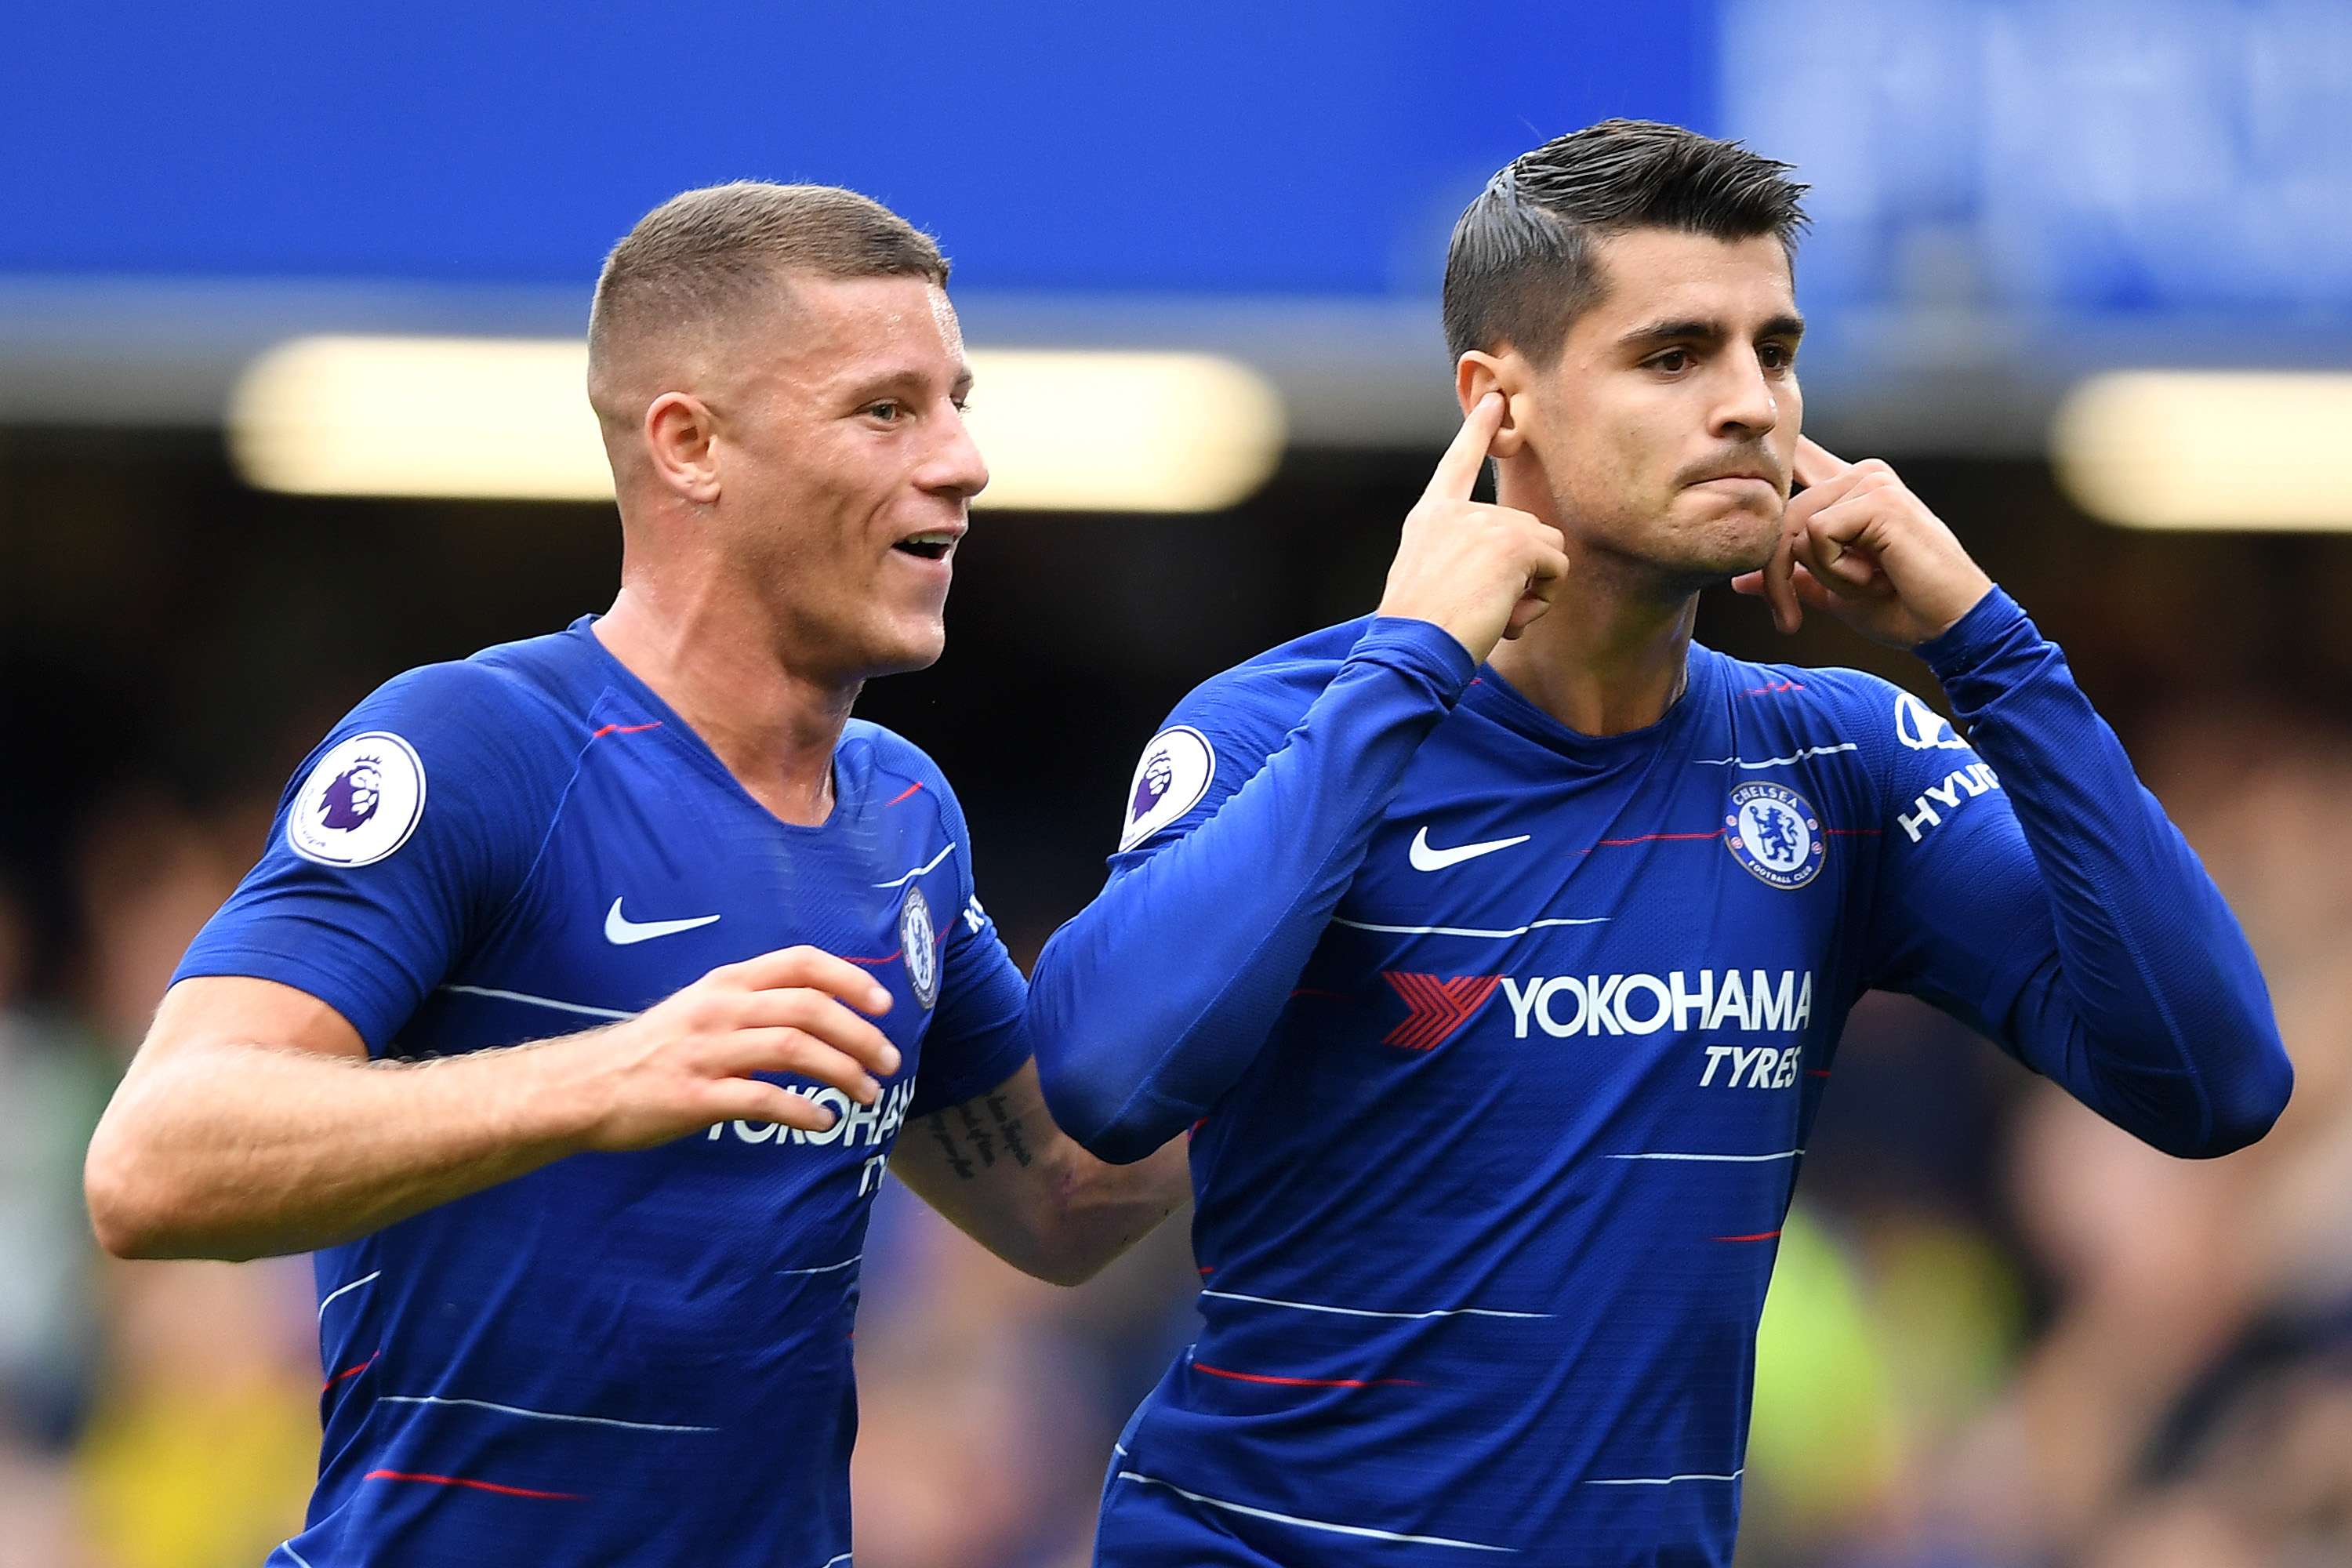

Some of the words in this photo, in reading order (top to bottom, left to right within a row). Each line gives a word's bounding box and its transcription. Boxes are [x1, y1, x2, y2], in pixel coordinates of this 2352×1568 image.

[1733, 786, 1798, 809] CHELSEA
[1748, 860, 1791, 884] FOOTBALL
[1501, 970, 1812, 1039] YOKOHAMA
[1700, 1045, 1802, 1089] TYRES
